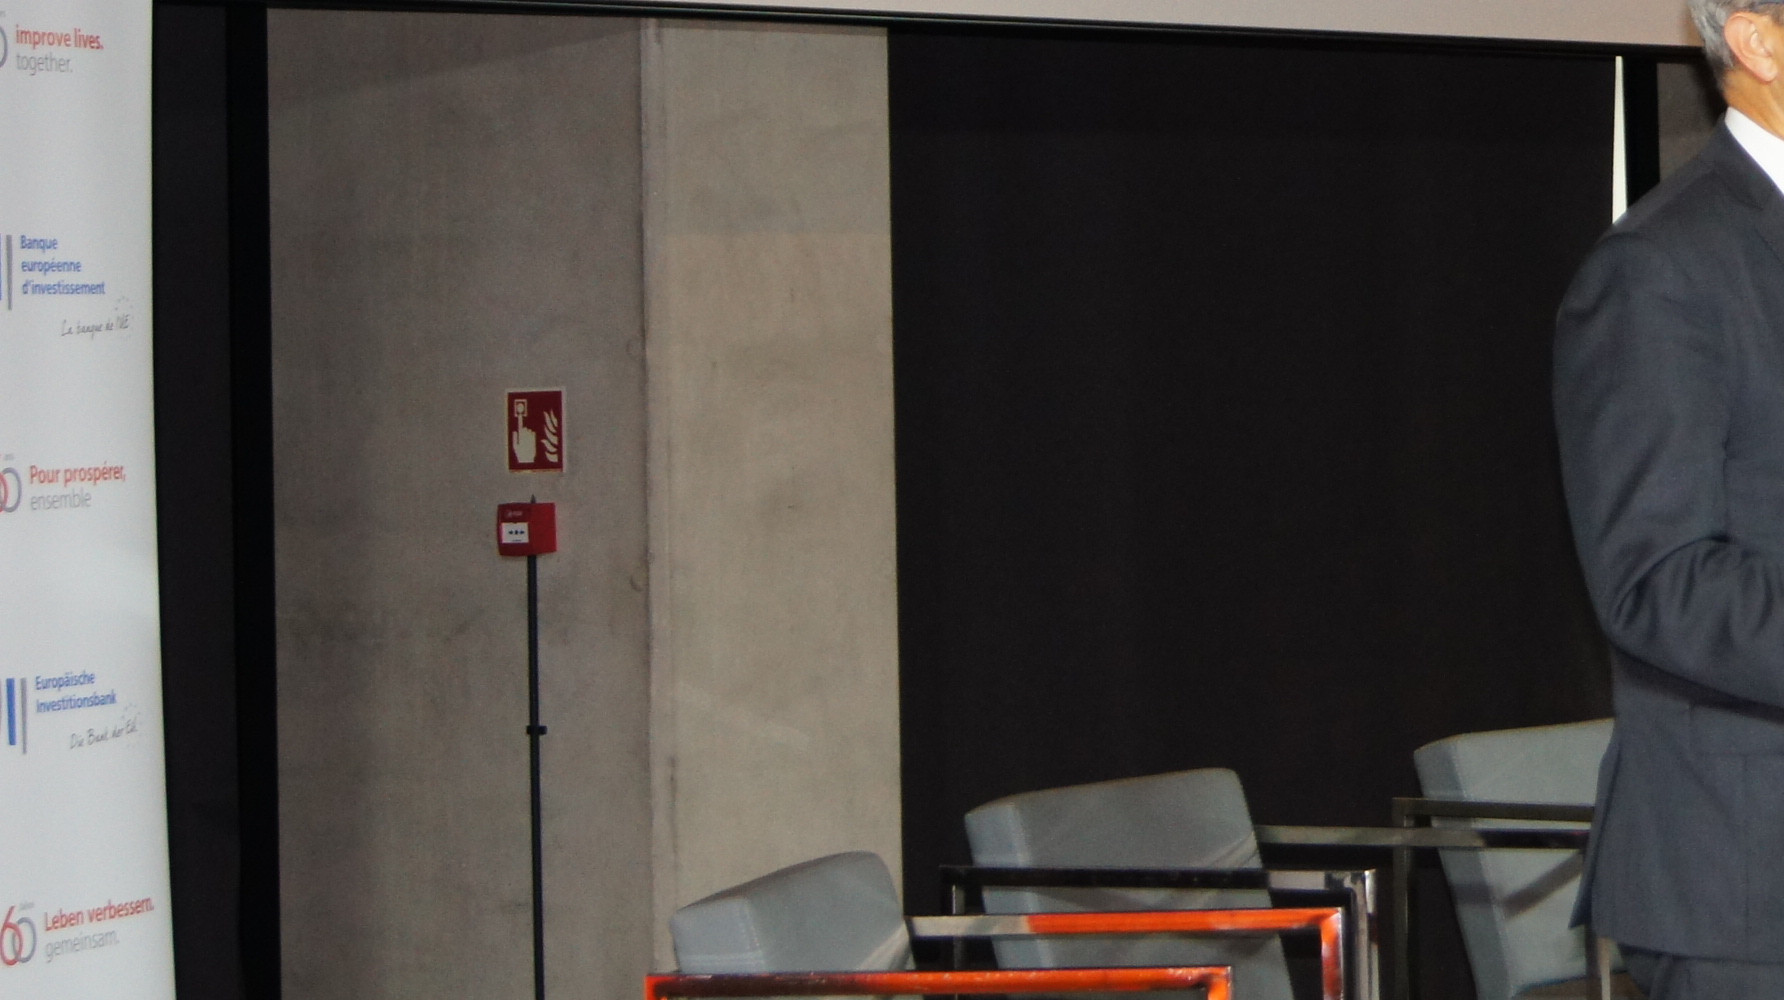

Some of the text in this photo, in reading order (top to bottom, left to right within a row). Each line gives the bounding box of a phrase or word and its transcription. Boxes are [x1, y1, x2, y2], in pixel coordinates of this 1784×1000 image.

[15, 24, 72, 50] improve
[73, 28, 104, 50] lives.
[16, 52, 73, 76] together.
[20, 234, 59, 253] Banque
[21, 258, 82, 276] européenne
[22, 279, 106, 295] d'investissement
[29, 460, 126, 487] Pour prospérer,
[30, 488, 92, 511] ensemble
[35, 668, 95, 691] Europäische
[36, 688, 117, 713] Investitionsbank
[44, 908, 84, 931] Leben
[44, 930, 120, 963] gemeinsam.
